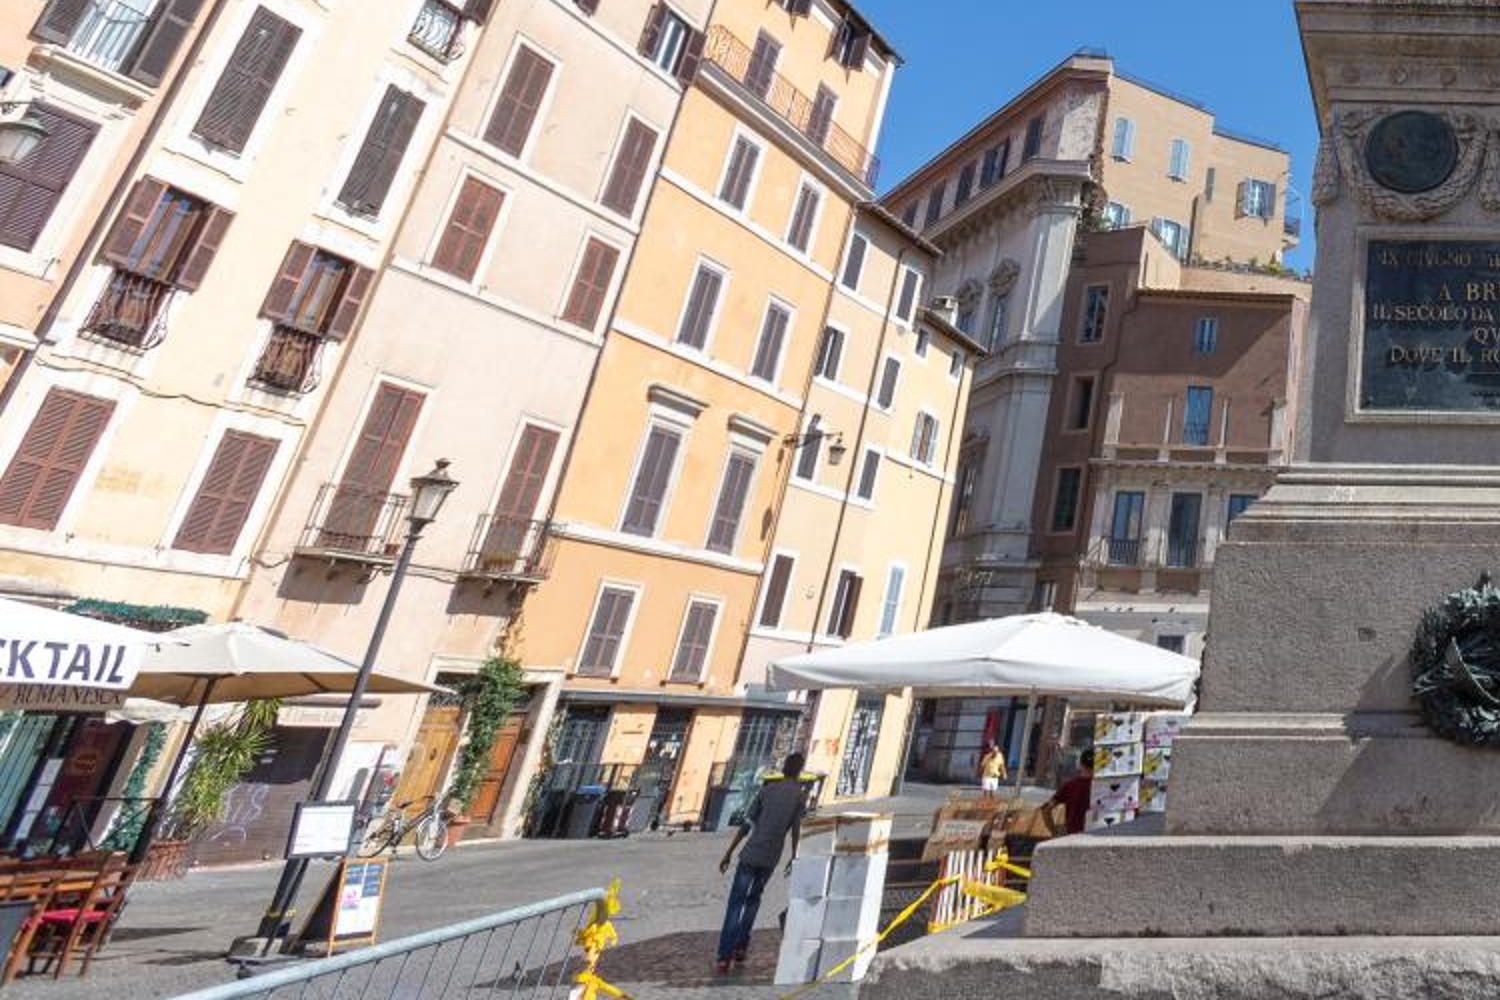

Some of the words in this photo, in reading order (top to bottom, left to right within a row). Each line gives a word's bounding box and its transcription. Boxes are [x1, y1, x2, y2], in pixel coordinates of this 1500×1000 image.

[1439, 282, 1452, 301] A
[1373, 304, 1392, 320] IL
[1395, 305, 1467, 321] SECOLO
[1472, 307, 1493, 322] DA
[1391, 345, 1442, 363] DOVE
[1452, 347, 1472, 363] IL
